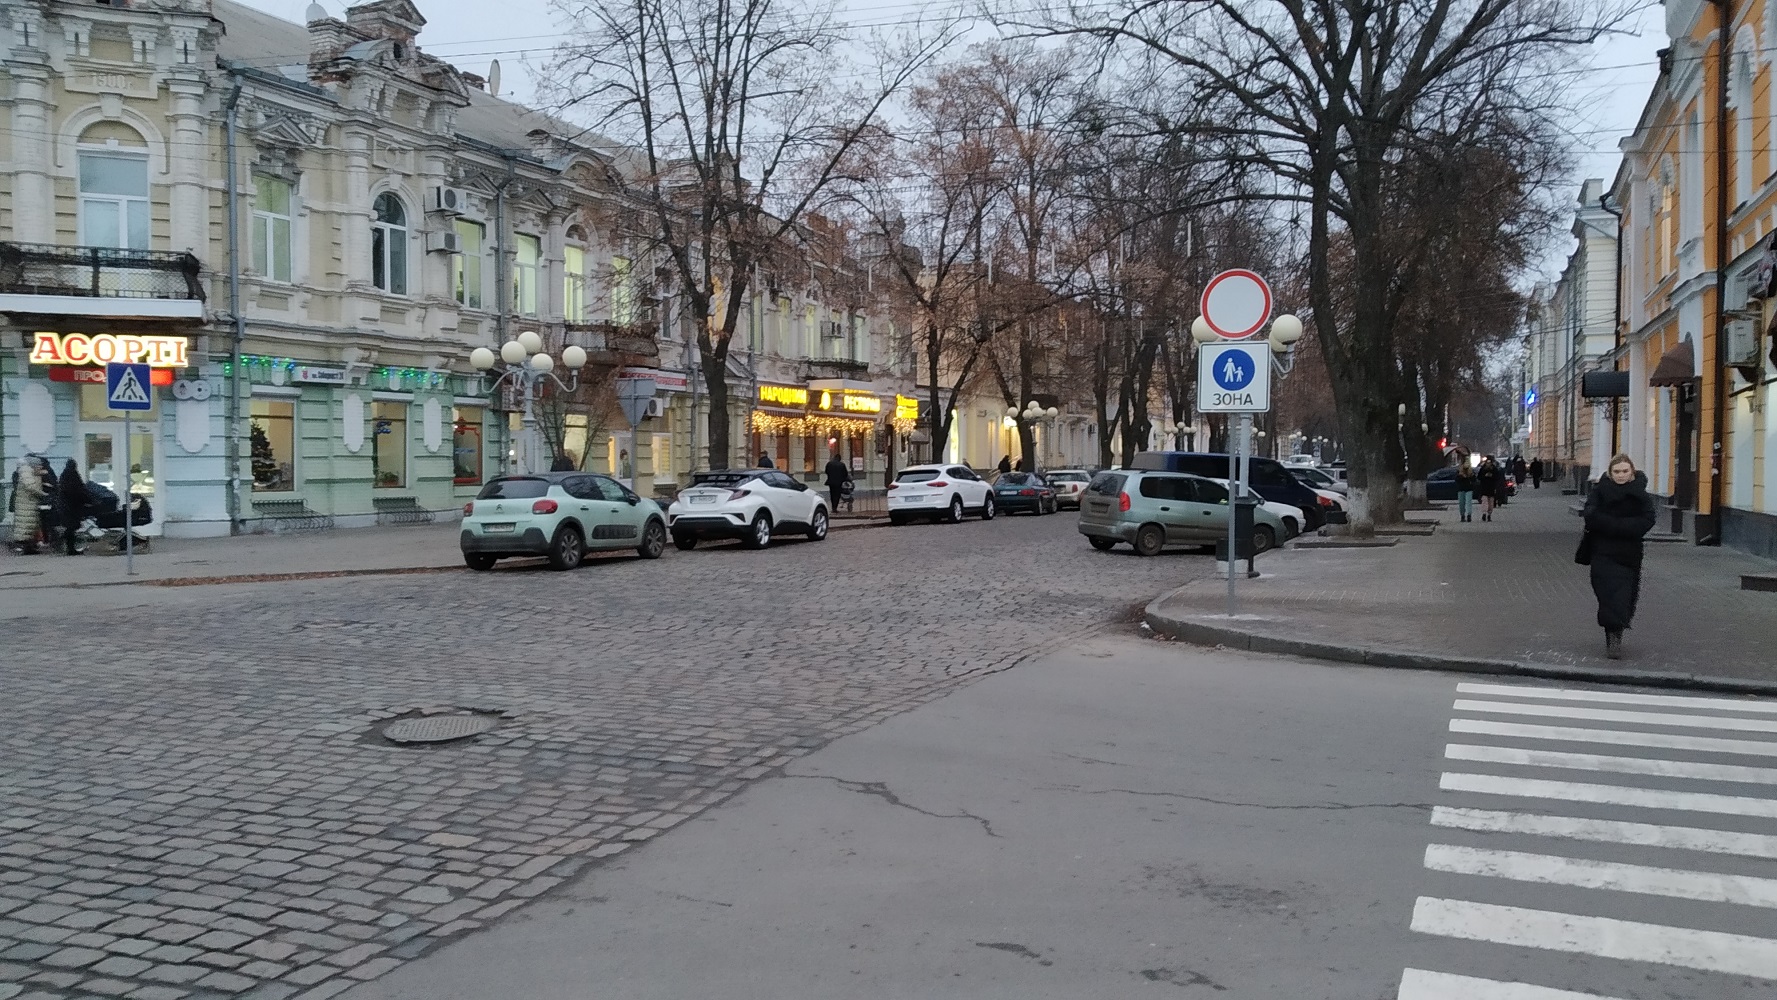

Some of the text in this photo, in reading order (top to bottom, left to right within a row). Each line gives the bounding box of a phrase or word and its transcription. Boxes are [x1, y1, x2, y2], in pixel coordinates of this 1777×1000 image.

[31, 332, 188, 366] АСОРТІ
[73, 369, 107, 382] ПРО
[1212, 392, 1253, 406] ЗОНА
